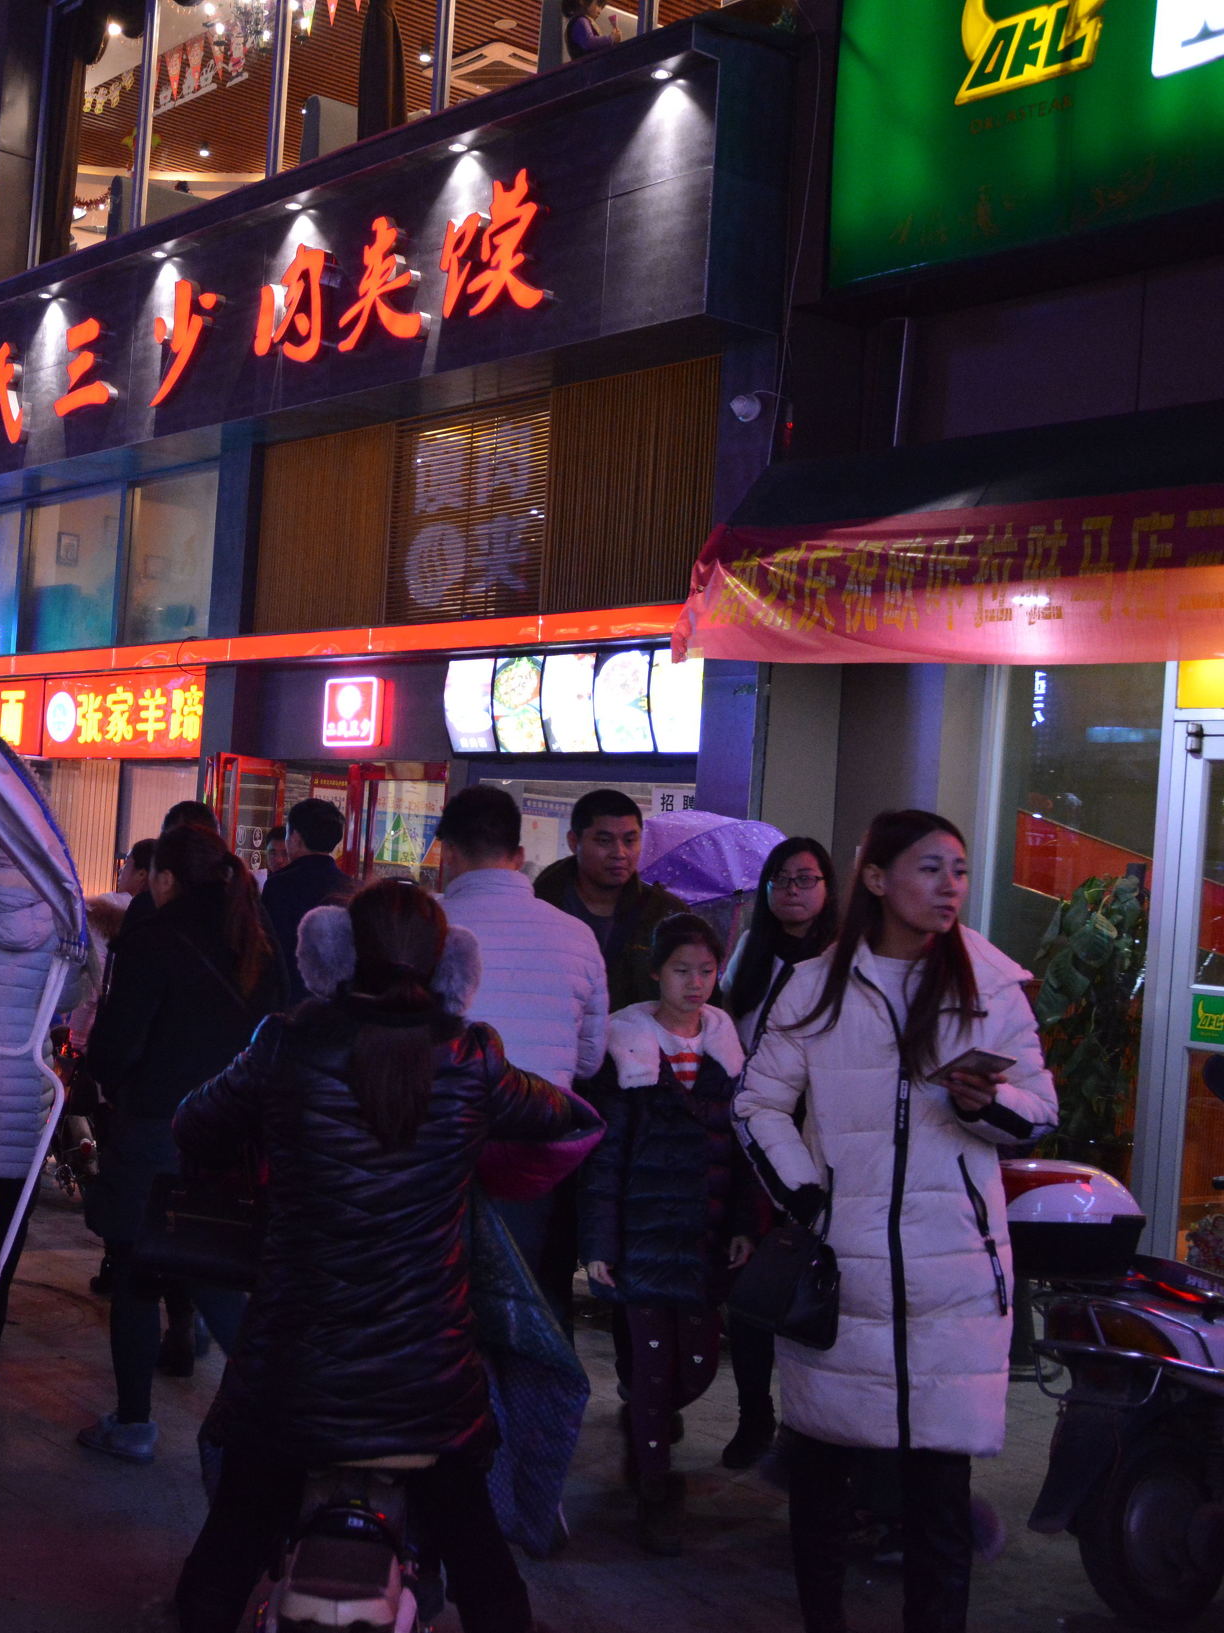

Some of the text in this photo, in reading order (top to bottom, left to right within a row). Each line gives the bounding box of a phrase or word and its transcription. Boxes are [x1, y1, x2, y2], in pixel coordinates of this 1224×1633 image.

[76, 686, 204, 743] 张家羊蹄
[660, 793, 697, 812] 招聘
